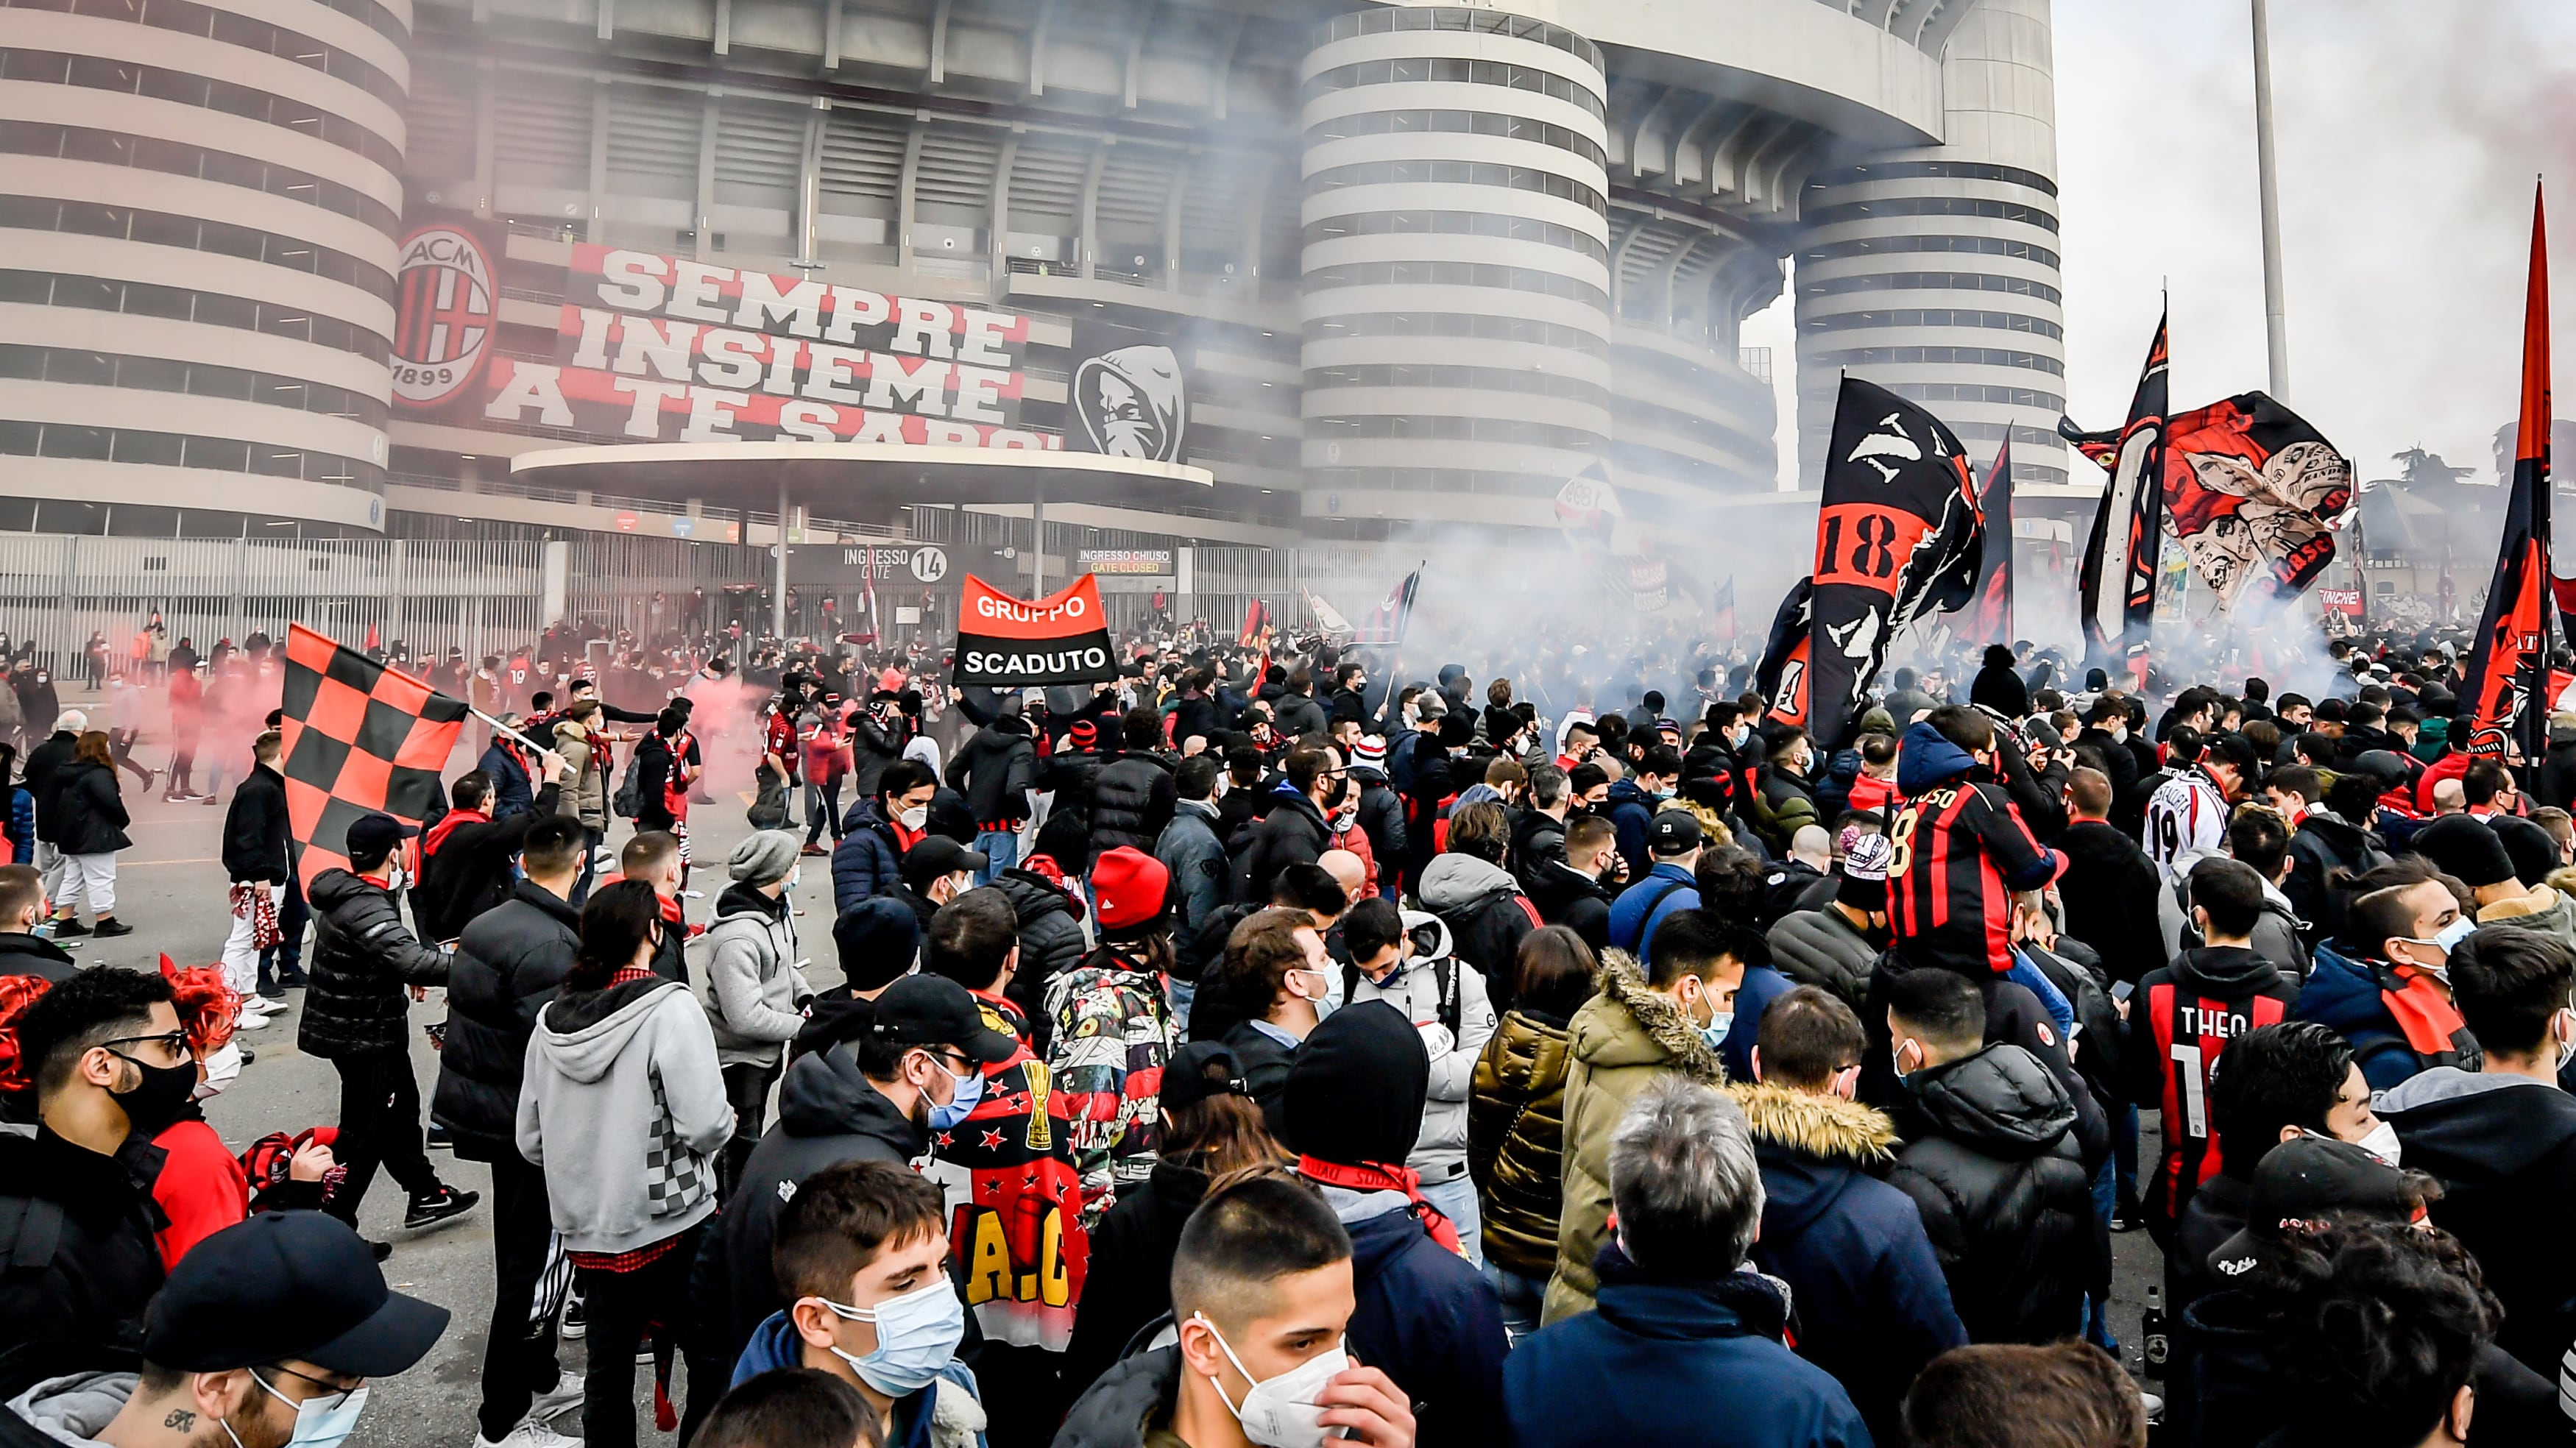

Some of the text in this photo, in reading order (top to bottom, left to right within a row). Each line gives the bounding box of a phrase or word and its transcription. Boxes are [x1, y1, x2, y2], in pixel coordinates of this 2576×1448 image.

[403, 238, 475, 274] ACM
[597, 249, 1016, 367] SEMPRE
[392, 365, 453, 386] 1899
[572, 308, 1011, 425] INSIEME
[484, 361, 575, 427] A
[624, 376, 750, 442] TE
[843, 548, 909, 566] INGRESSO
[1080, 550, 1170, 561] INGRESSO CHIUSO
[1819, 514, 1896, 578] 18
[1090, 562, 1159, 573] GATE CLOSED
[977, 595, 1086, 623] GRUPPO
[511, 670, 526, 684] 19
[964, 647, 1106, 675] SCADUTO
[1886, 808, 1919, 878] 8
[2150, 804, 2179, 865] 19
[2181, 1007, 2247, 1039] THEO
